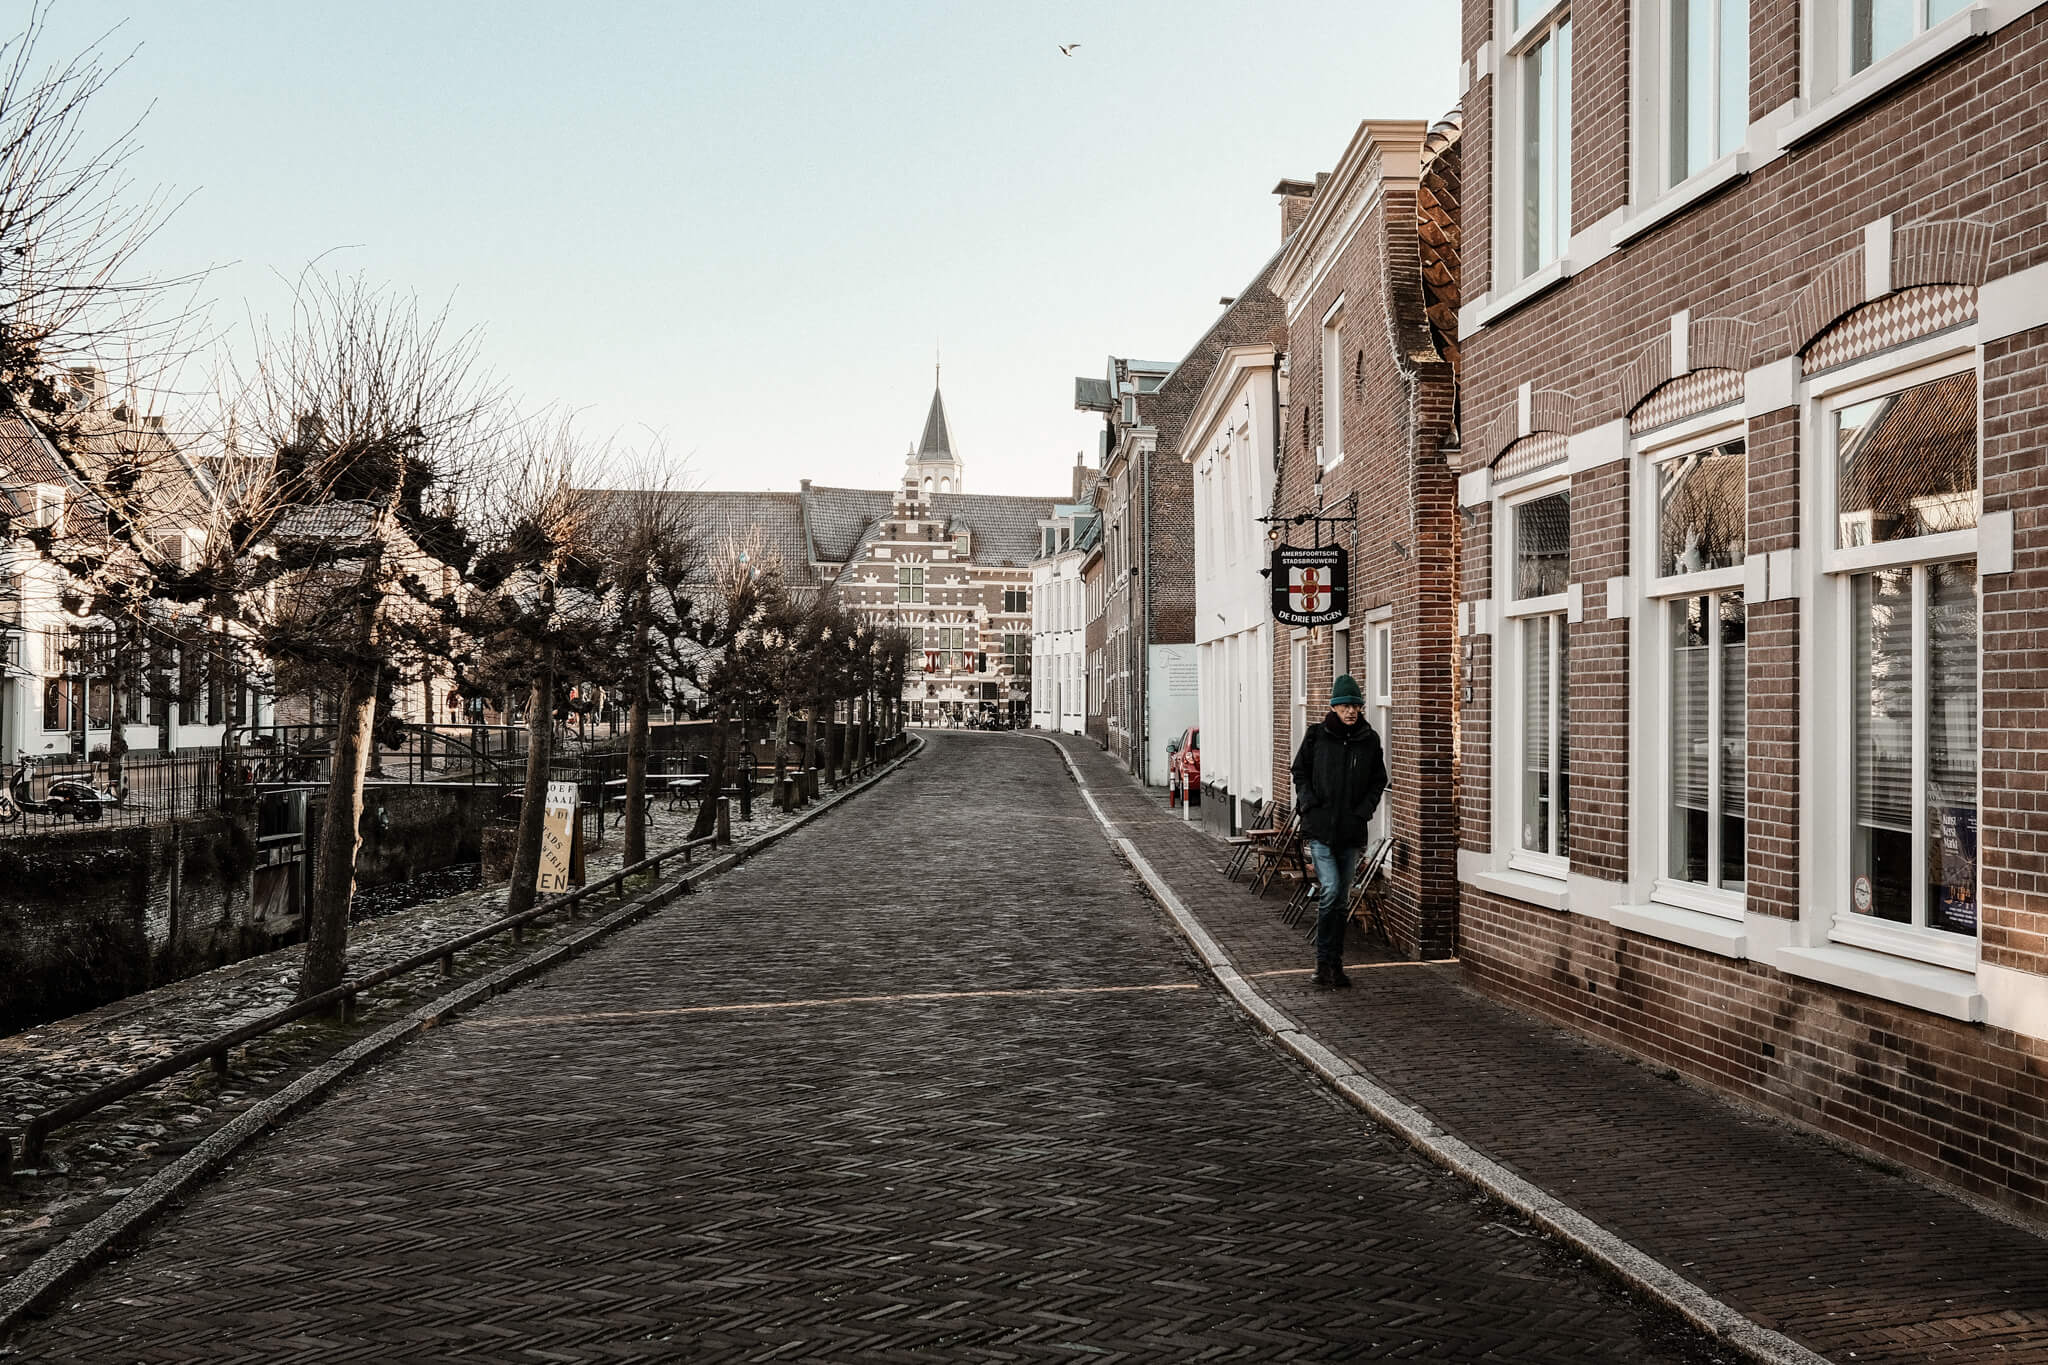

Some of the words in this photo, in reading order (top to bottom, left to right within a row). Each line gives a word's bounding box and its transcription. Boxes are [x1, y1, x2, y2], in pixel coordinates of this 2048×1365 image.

[1279, 610, 1290, 621] DE
[1291, 614, 1310, 623] DRIE
[1311, 609, 1343, 623] RINGEN
